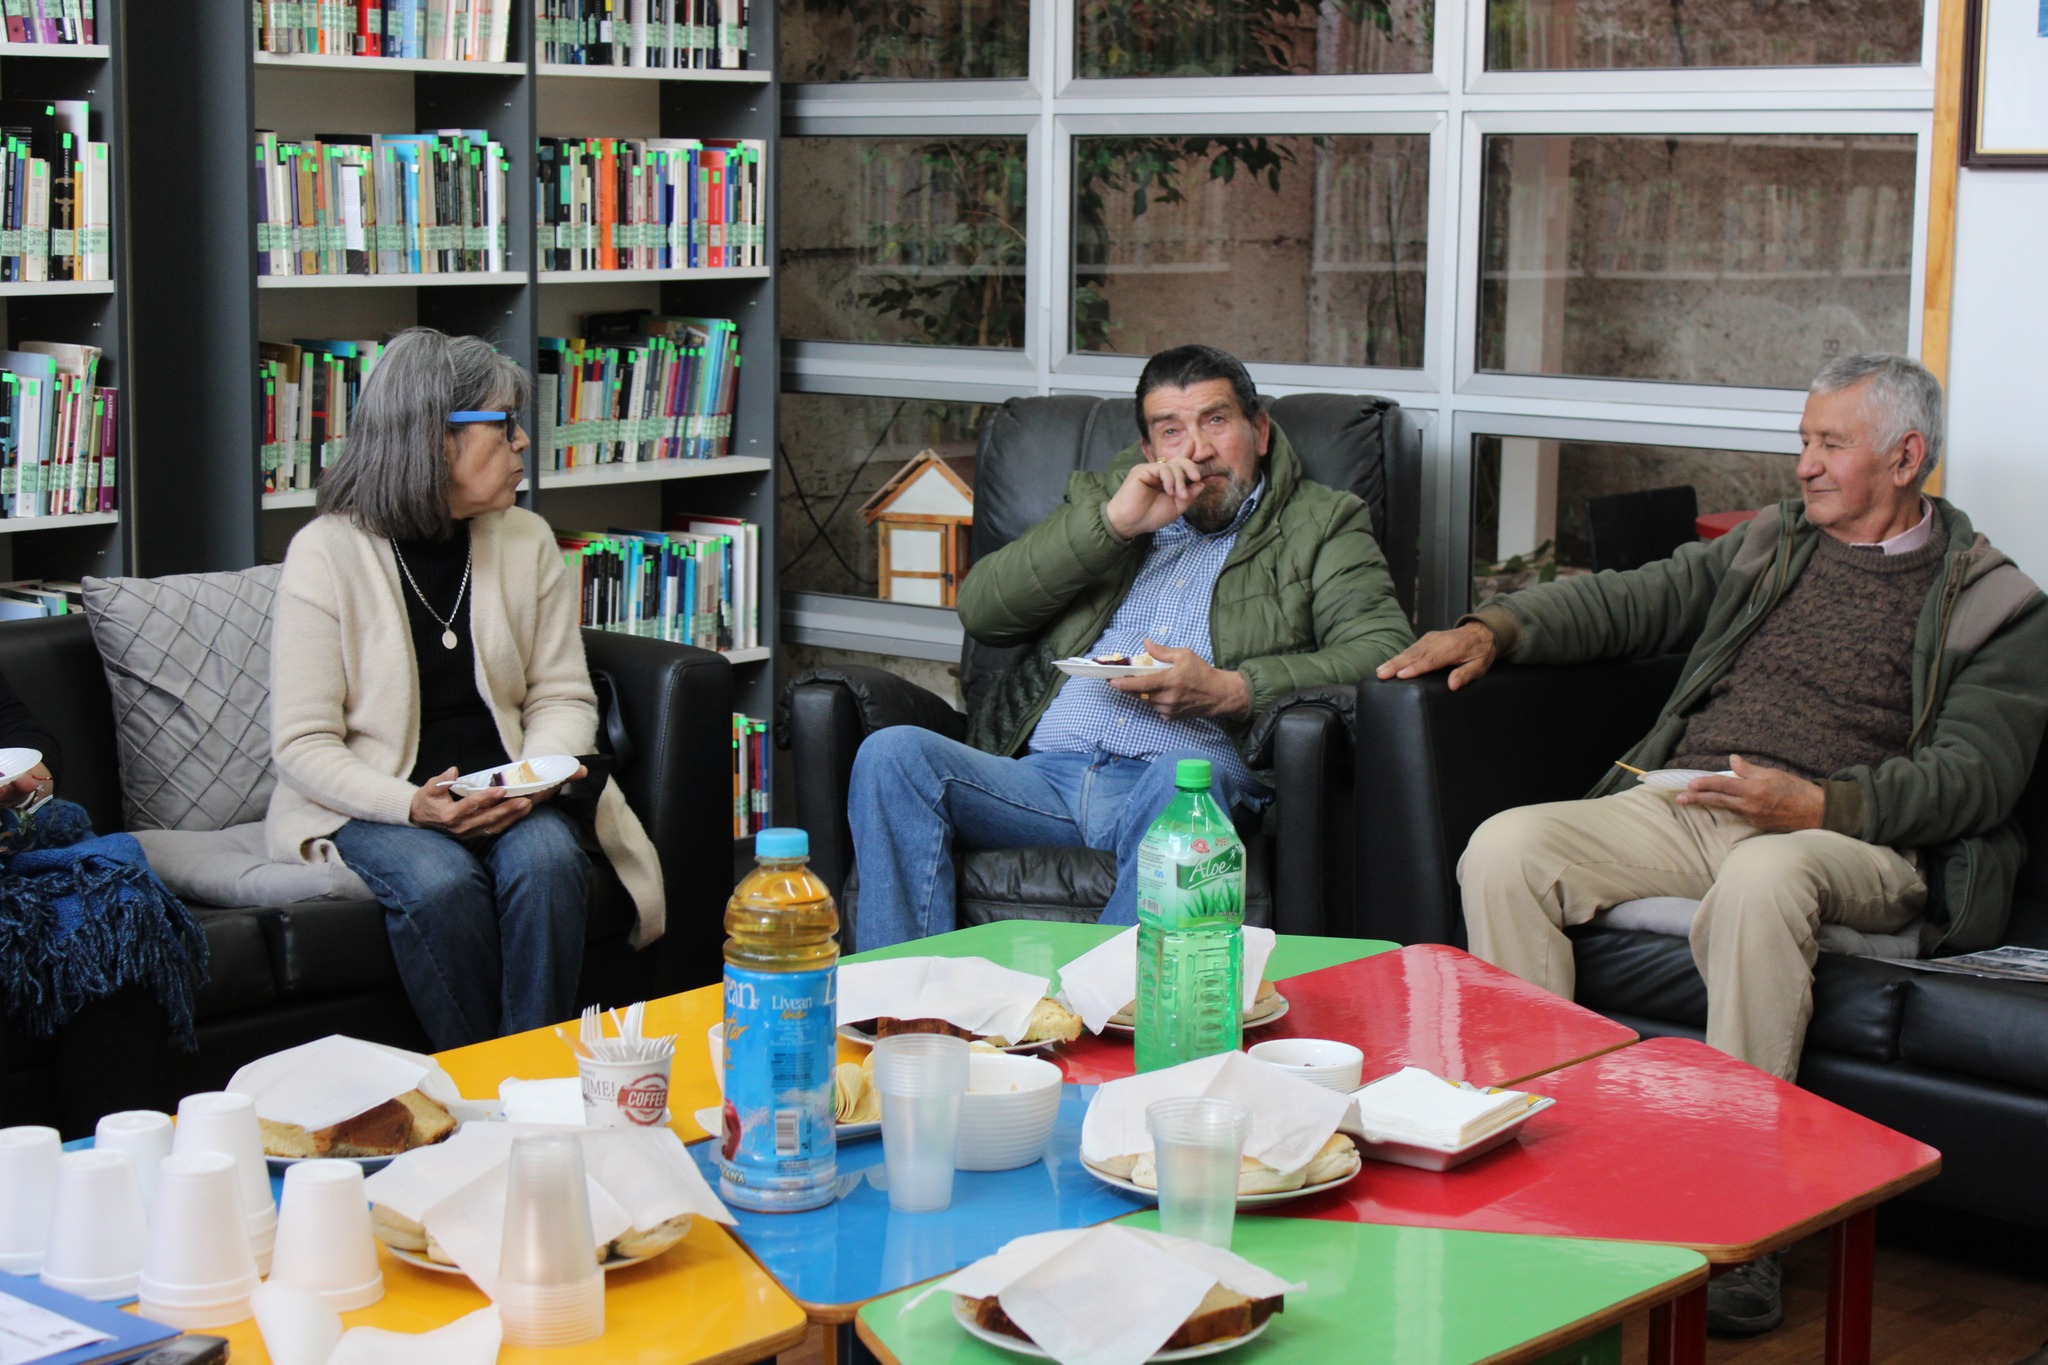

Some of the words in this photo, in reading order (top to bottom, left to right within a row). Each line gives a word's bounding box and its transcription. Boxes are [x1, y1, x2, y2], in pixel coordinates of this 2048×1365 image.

[1188, 857, 1232, 883] Aloe
[772, 995, 813, 1010] Livean
[627, 1091, 666, 1107] COFFEE
